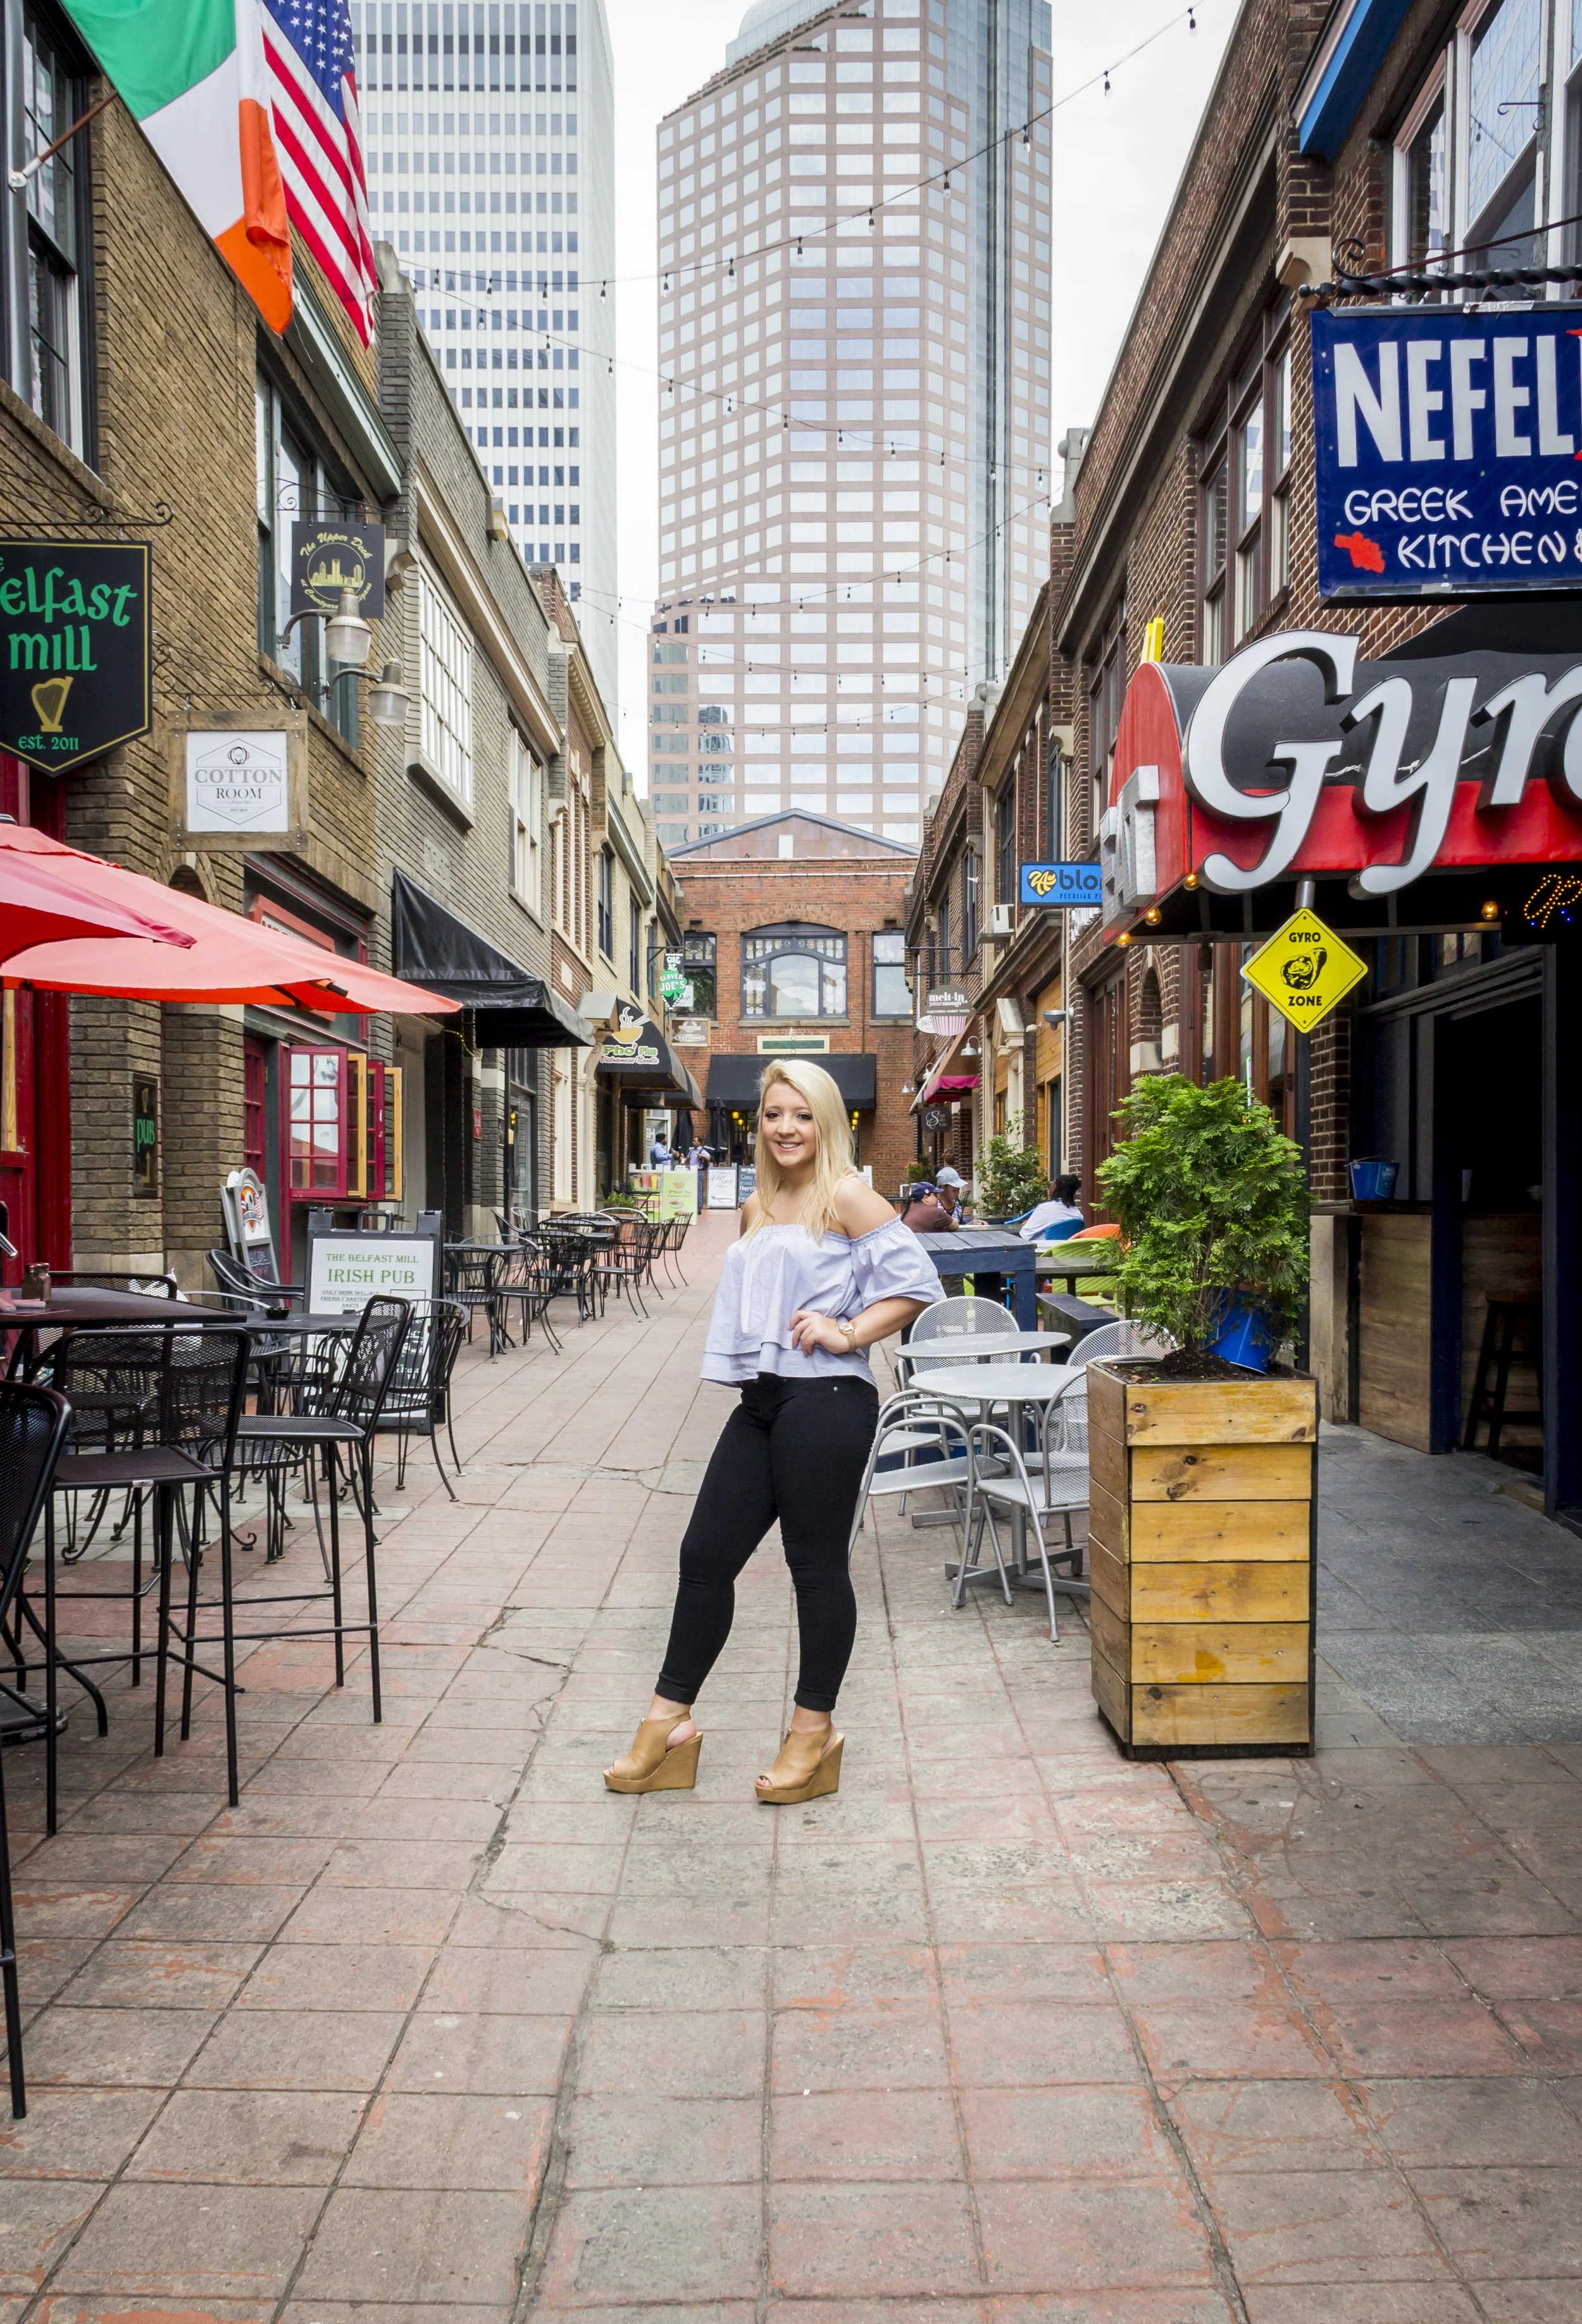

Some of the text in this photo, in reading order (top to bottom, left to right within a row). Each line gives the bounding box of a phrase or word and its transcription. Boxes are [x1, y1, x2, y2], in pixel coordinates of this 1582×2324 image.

[1334, 335, 1582, 467] NEFEL
[1344, 480, 1582, 525] GREEK AME
[300, 532, 373, 559] The Upper Deck
[1398, 530, 1567, 569] KITCHEN
[8, 625, 97, 671] mill
[51, 736, 79, 751] 2011
[194, 769, 283, 784] COTTON
[216, 788, 263, 799] ROOM
[1059, 869, 1102, 890] blo
[1289, 932, 1321, 942] GYRO
[659, 973, 683, 982] CLOVER
[659, 981, 686, 992] JOE'S
[1288, 996, 1322, 1006] ZONE
[639, 1046, 657, 1055] Plus
[601, 1055, 659, 1064] Vietnamese Noodle
[325, 1253, 419, 1263] THE BELFAST MILL
[328, 1268, 415, 1284] IRISH PUB
